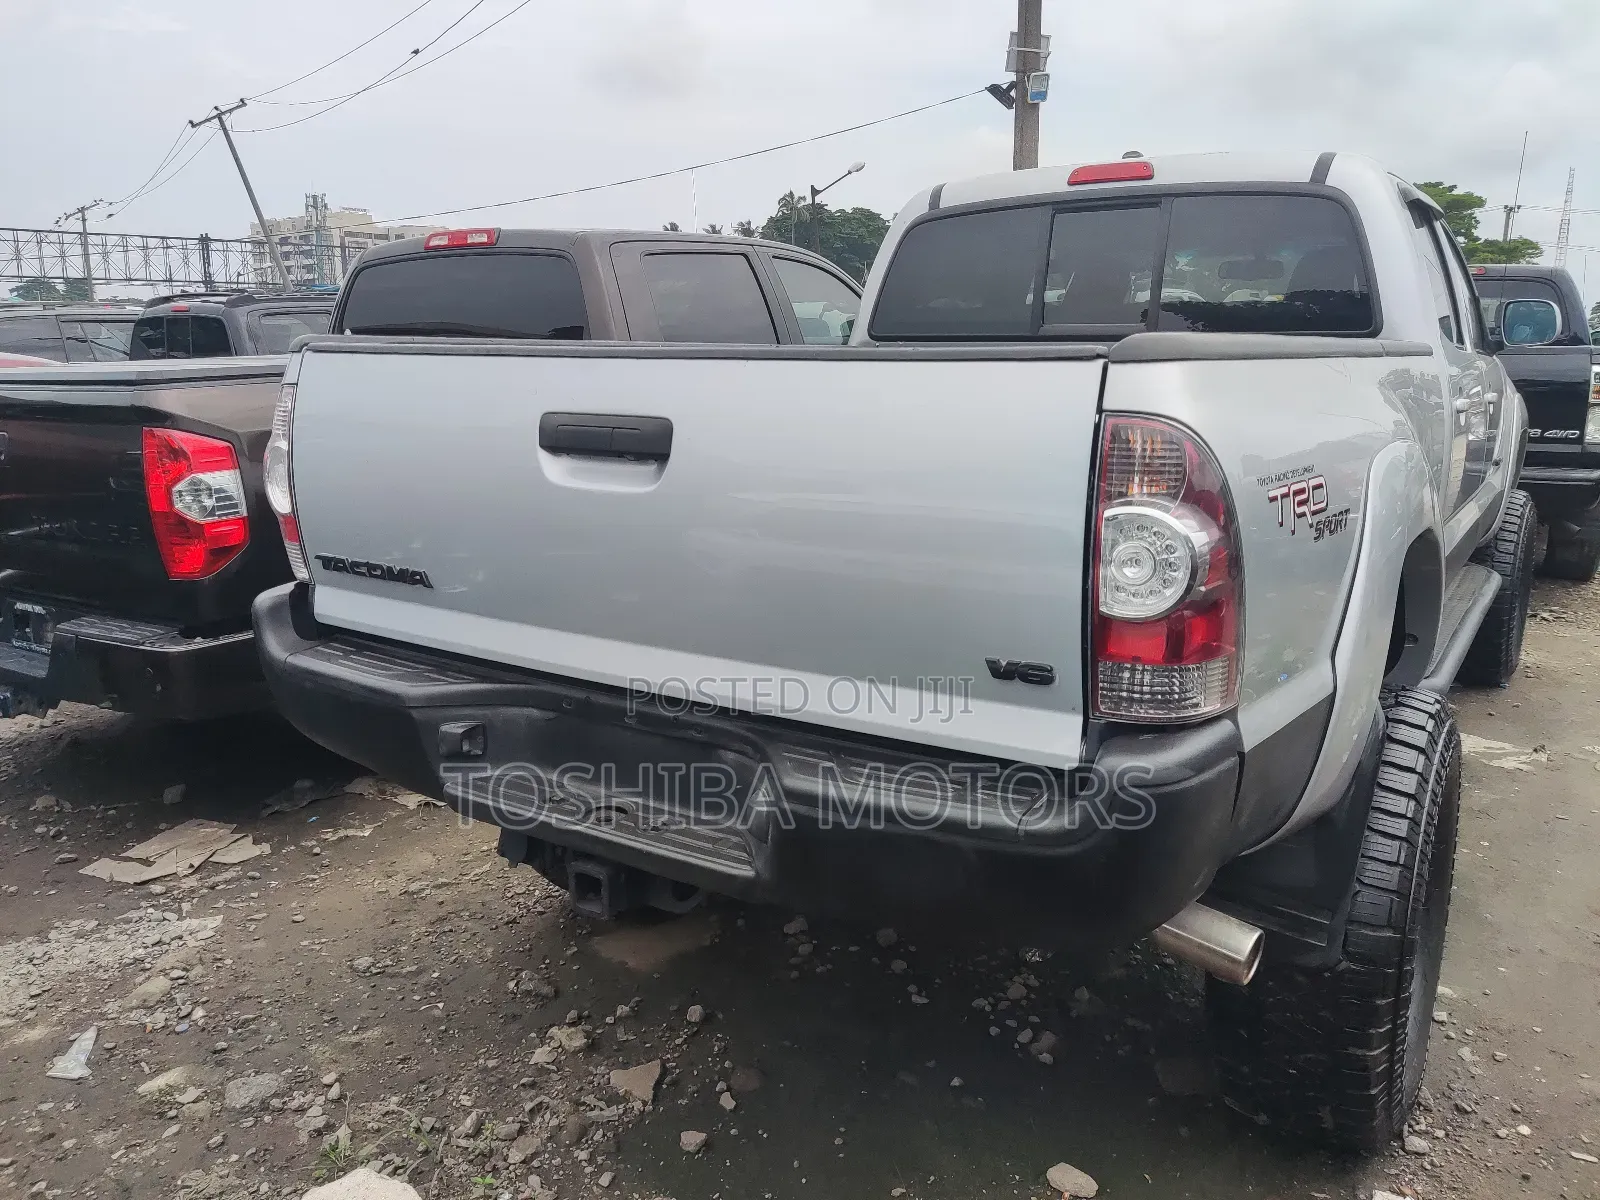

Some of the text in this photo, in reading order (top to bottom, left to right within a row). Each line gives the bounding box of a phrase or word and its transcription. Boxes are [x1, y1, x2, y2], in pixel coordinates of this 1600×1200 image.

[1543, 429, 1580, 438] 4WD
[1267, 475, 1328, 536] TRD
[1313, 508, 1350, 542] SPORT
[314, 553, 434, 588] TACOMA
[985, 656, 1056, 685] V6
